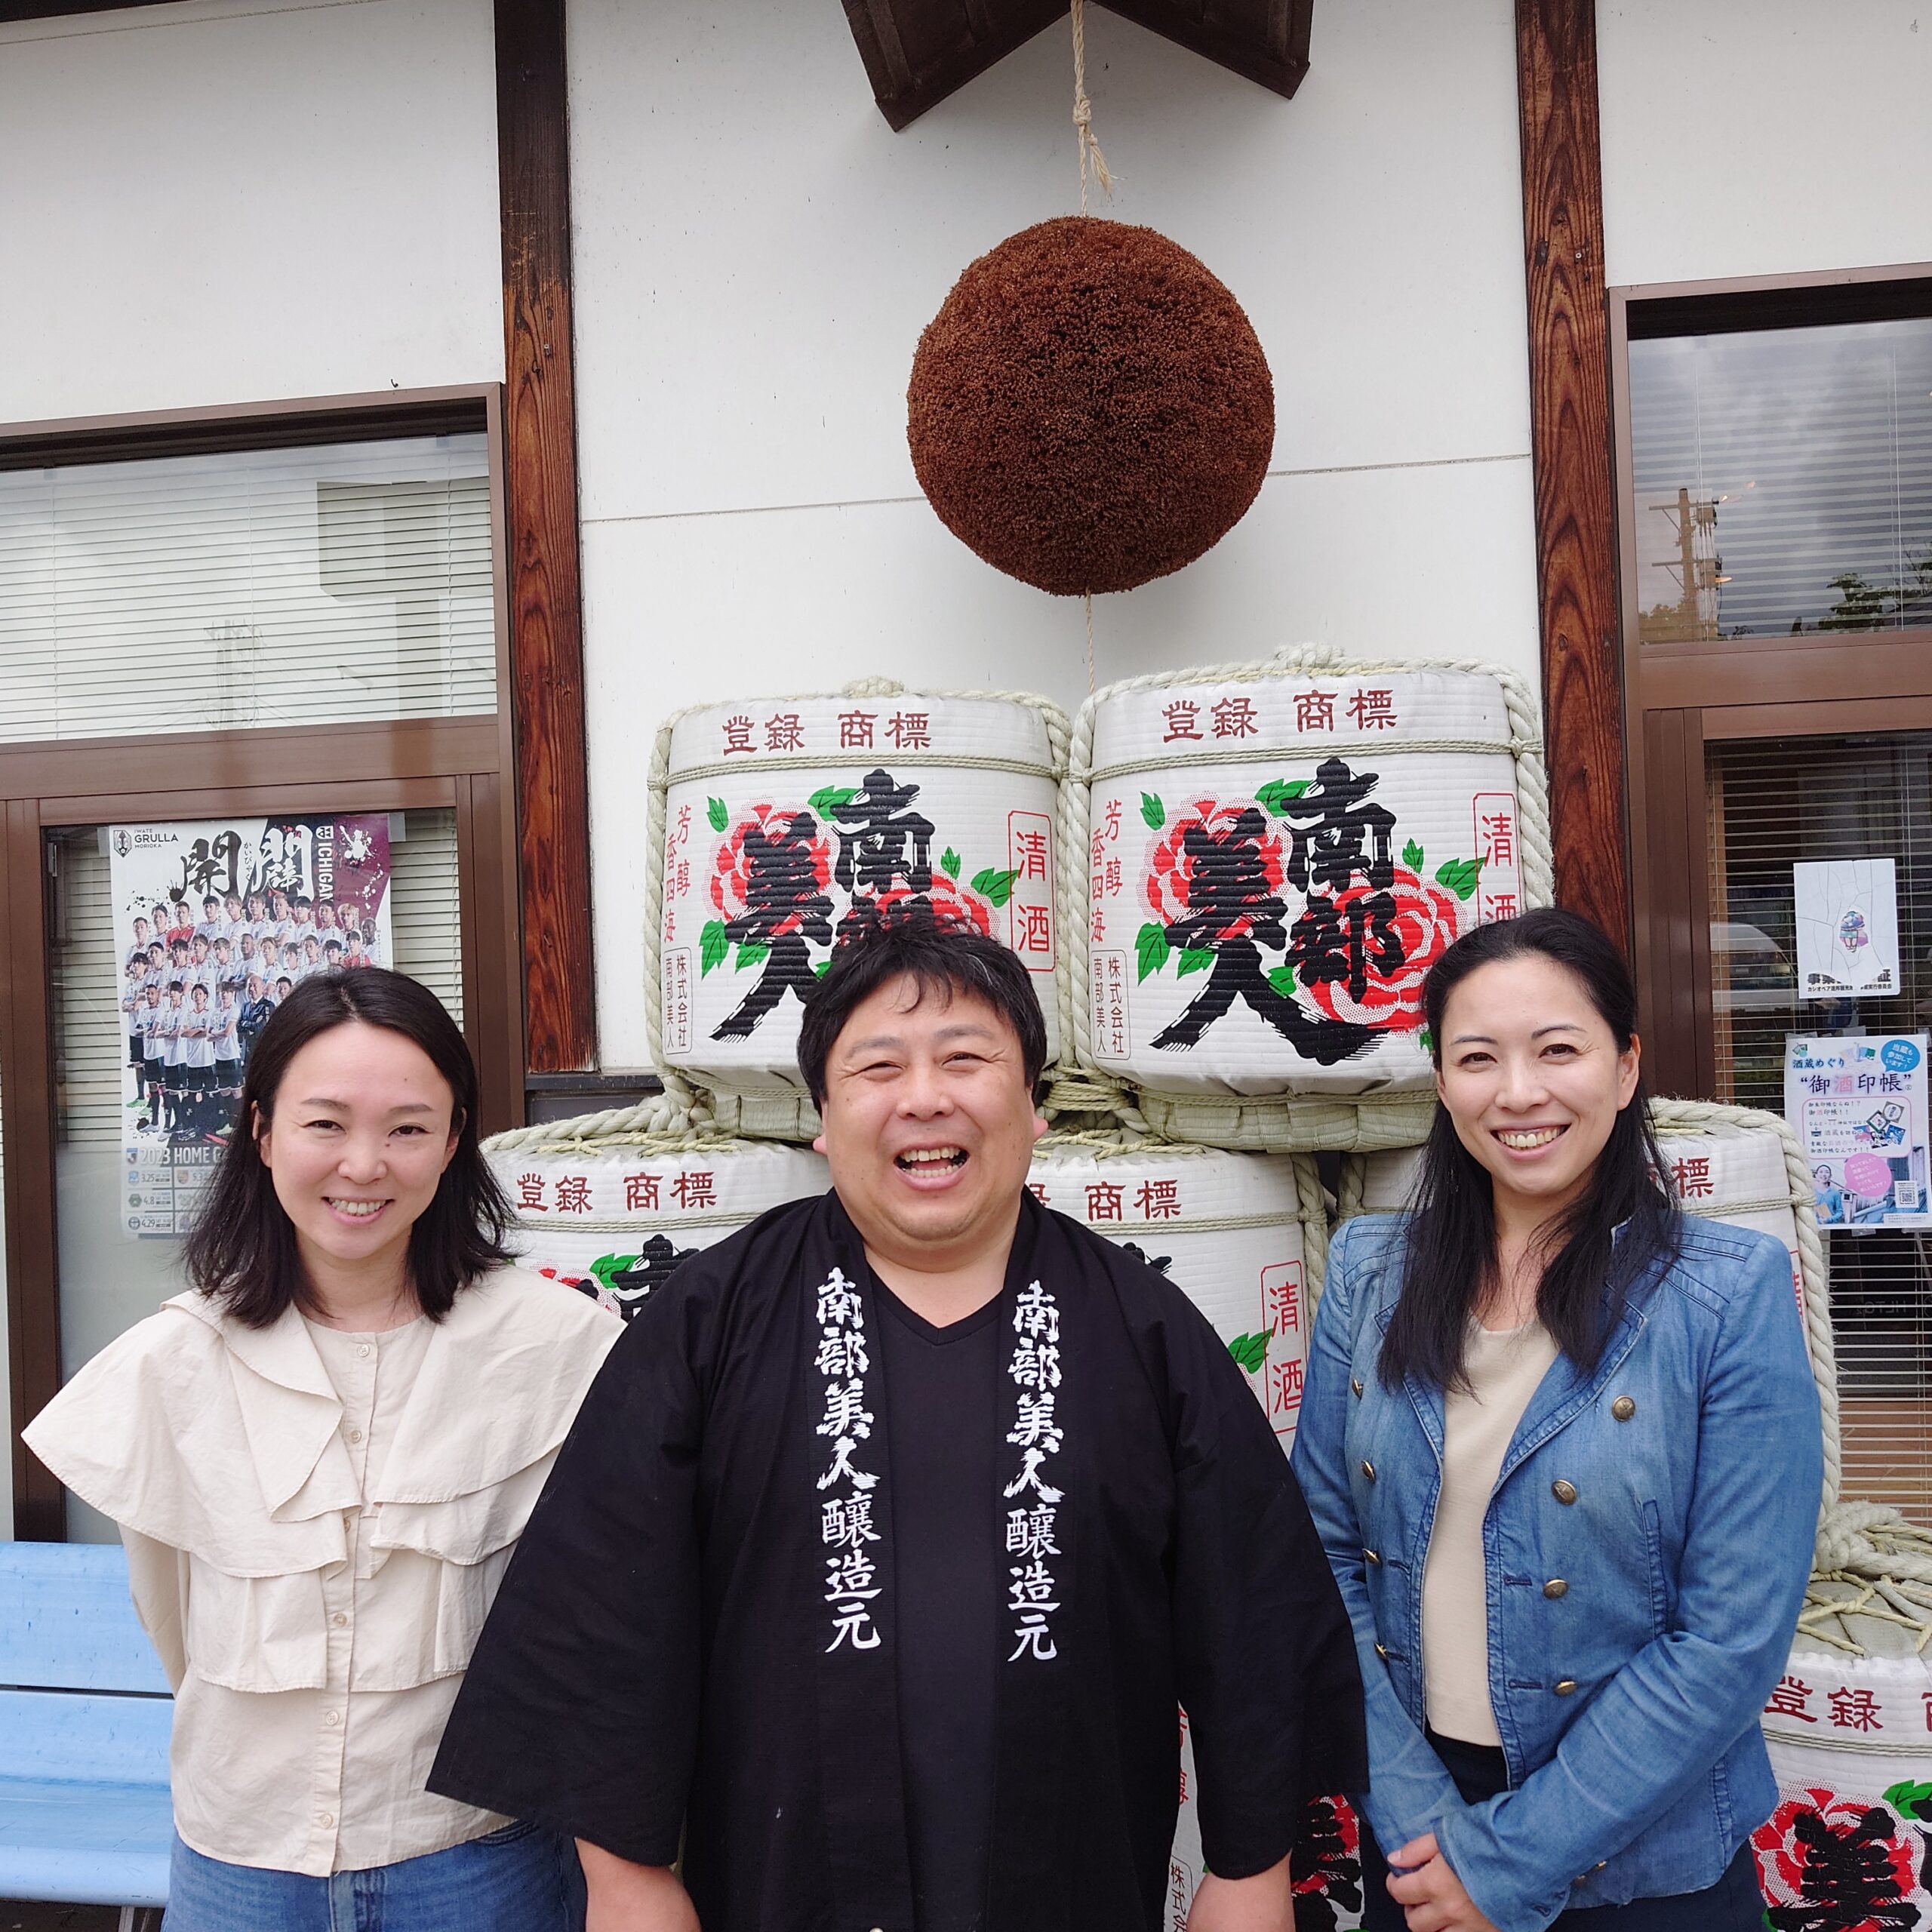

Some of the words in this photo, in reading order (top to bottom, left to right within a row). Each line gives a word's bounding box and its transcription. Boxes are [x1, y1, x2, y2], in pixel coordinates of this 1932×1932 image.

[722, 713, 805, 755] 登録
[838, 710, 931, 749] 商標
[1161, 697, 1259, 743] 登録
[1292, 689, 1398, 732] 商標
[134, 833, 179, 843] GRULLA
[1105, 799, 1123, 897] 芳醇
[1017, 830, 1049, 952] 清酒
[676, 954, 688, 1048] 株式会社
[1094, 957, 1106, 1053] 南部美人
[1108, 956, 1124, 1054] 株式会社
[1792, 1058, 1845, 1069] 酒蔵めぐり
[140, 1147, 171, 1166] 2023
[174, 1147, 211, 1164] HOME
[516, 1172, 594, 1214] 登録
[623, 1171, 718, 1211] 商標
[1084, 1179, 1183, 1222] 商標
[1269, 1281, 1303, 1414] 清酒
[1764, 1675, 1884, 1732] 登録
